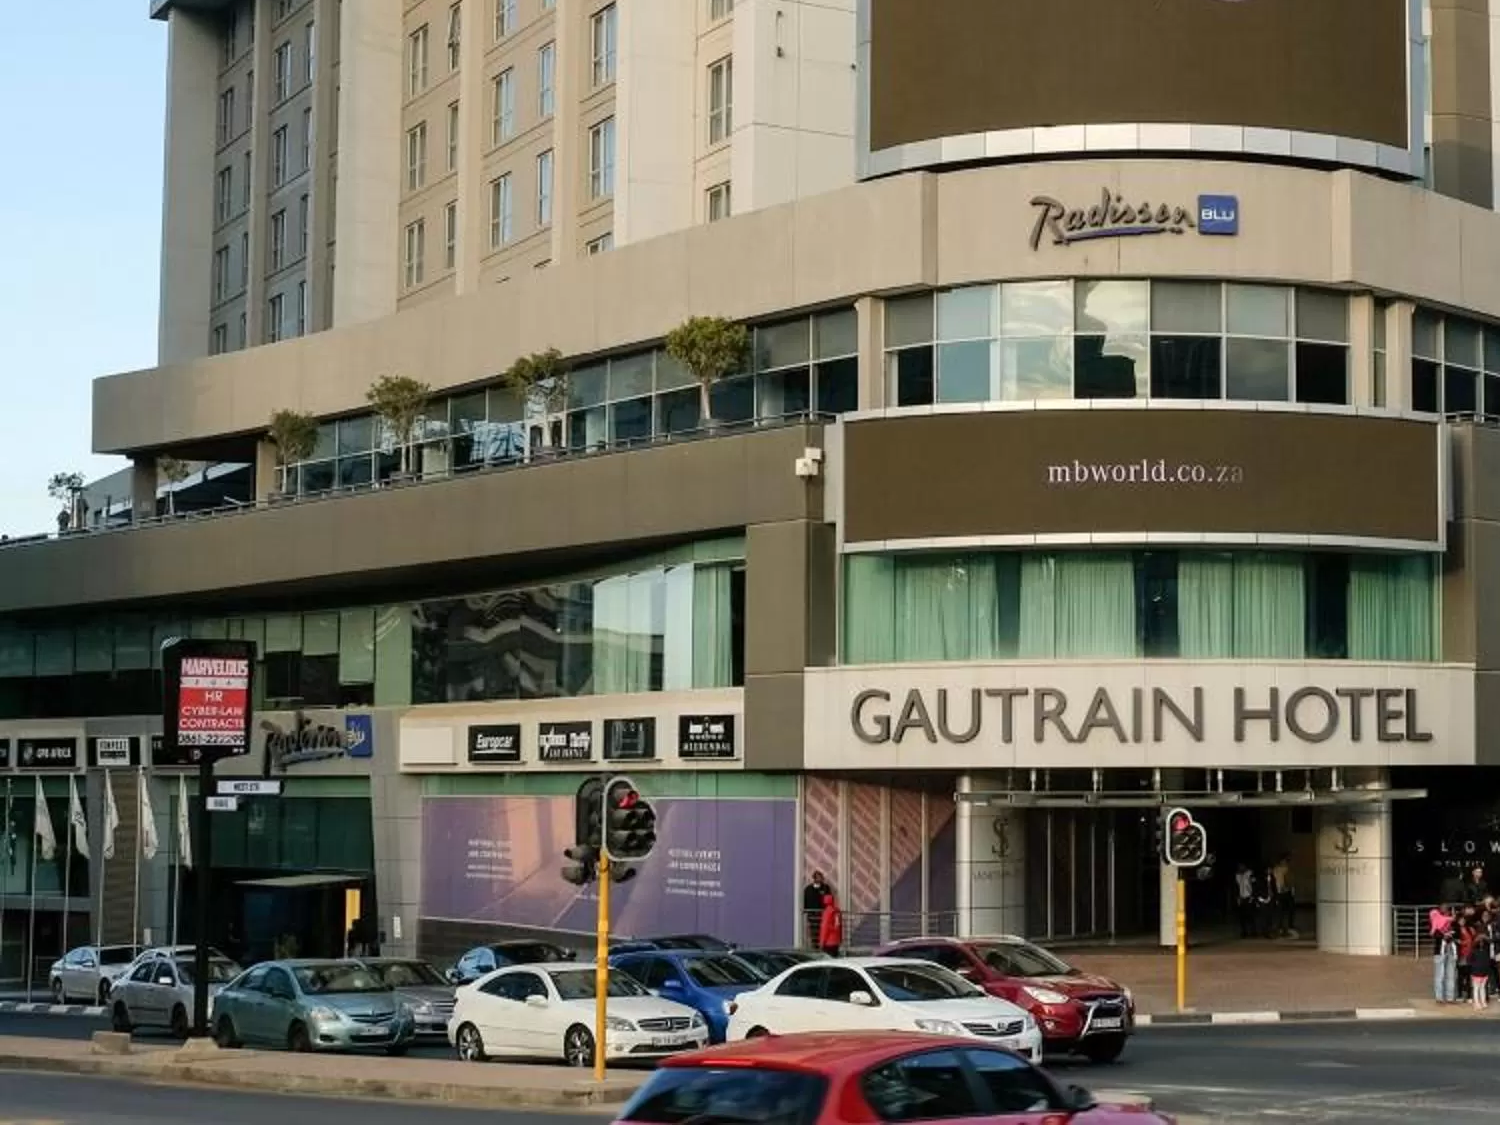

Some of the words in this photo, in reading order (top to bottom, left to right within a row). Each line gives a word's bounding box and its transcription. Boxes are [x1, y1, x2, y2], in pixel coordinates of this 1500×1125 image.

[1029, 186, 1196, 252] Radisson
[1201, 208, 1236, 221] BLU
[1048, 458, 1244, 484] mbworld.co.za
[204, 690, 223, 702] HR
[850, 686, 1204, 743] GAUTRAIN
[1232, 686, 1434, 743] HOTEL
[475, 733, 513, 749] Europcar
